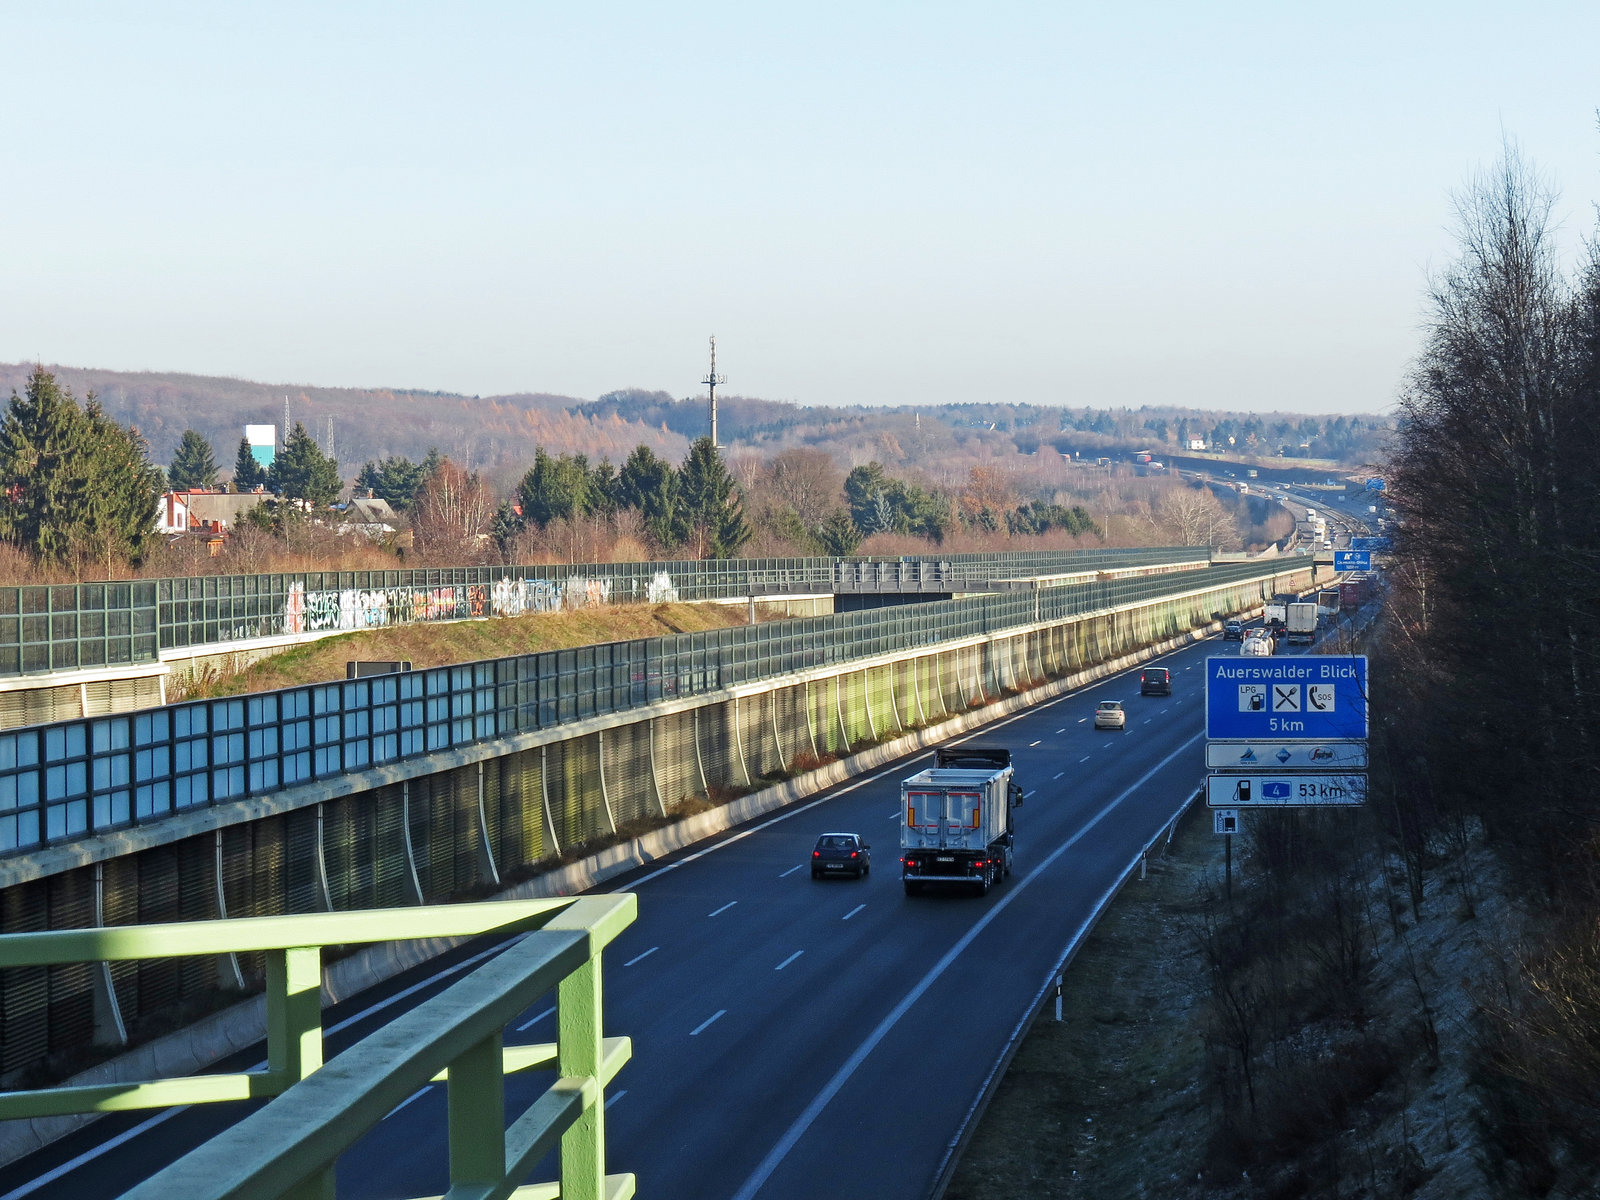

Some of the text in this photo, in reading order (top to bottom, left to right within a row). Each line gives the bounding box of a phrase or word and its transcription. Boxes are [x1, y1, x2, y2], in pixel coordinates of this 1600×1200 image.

[1216, 665, 1357, 679] Auerswalder Blick
[1240, 686, 1257, 694] LPG
[1269, 718, 1304, 731] 5 km
[1272, 784, 1280, 796] 4
[1299, 783, 1343, 797] 53 km
